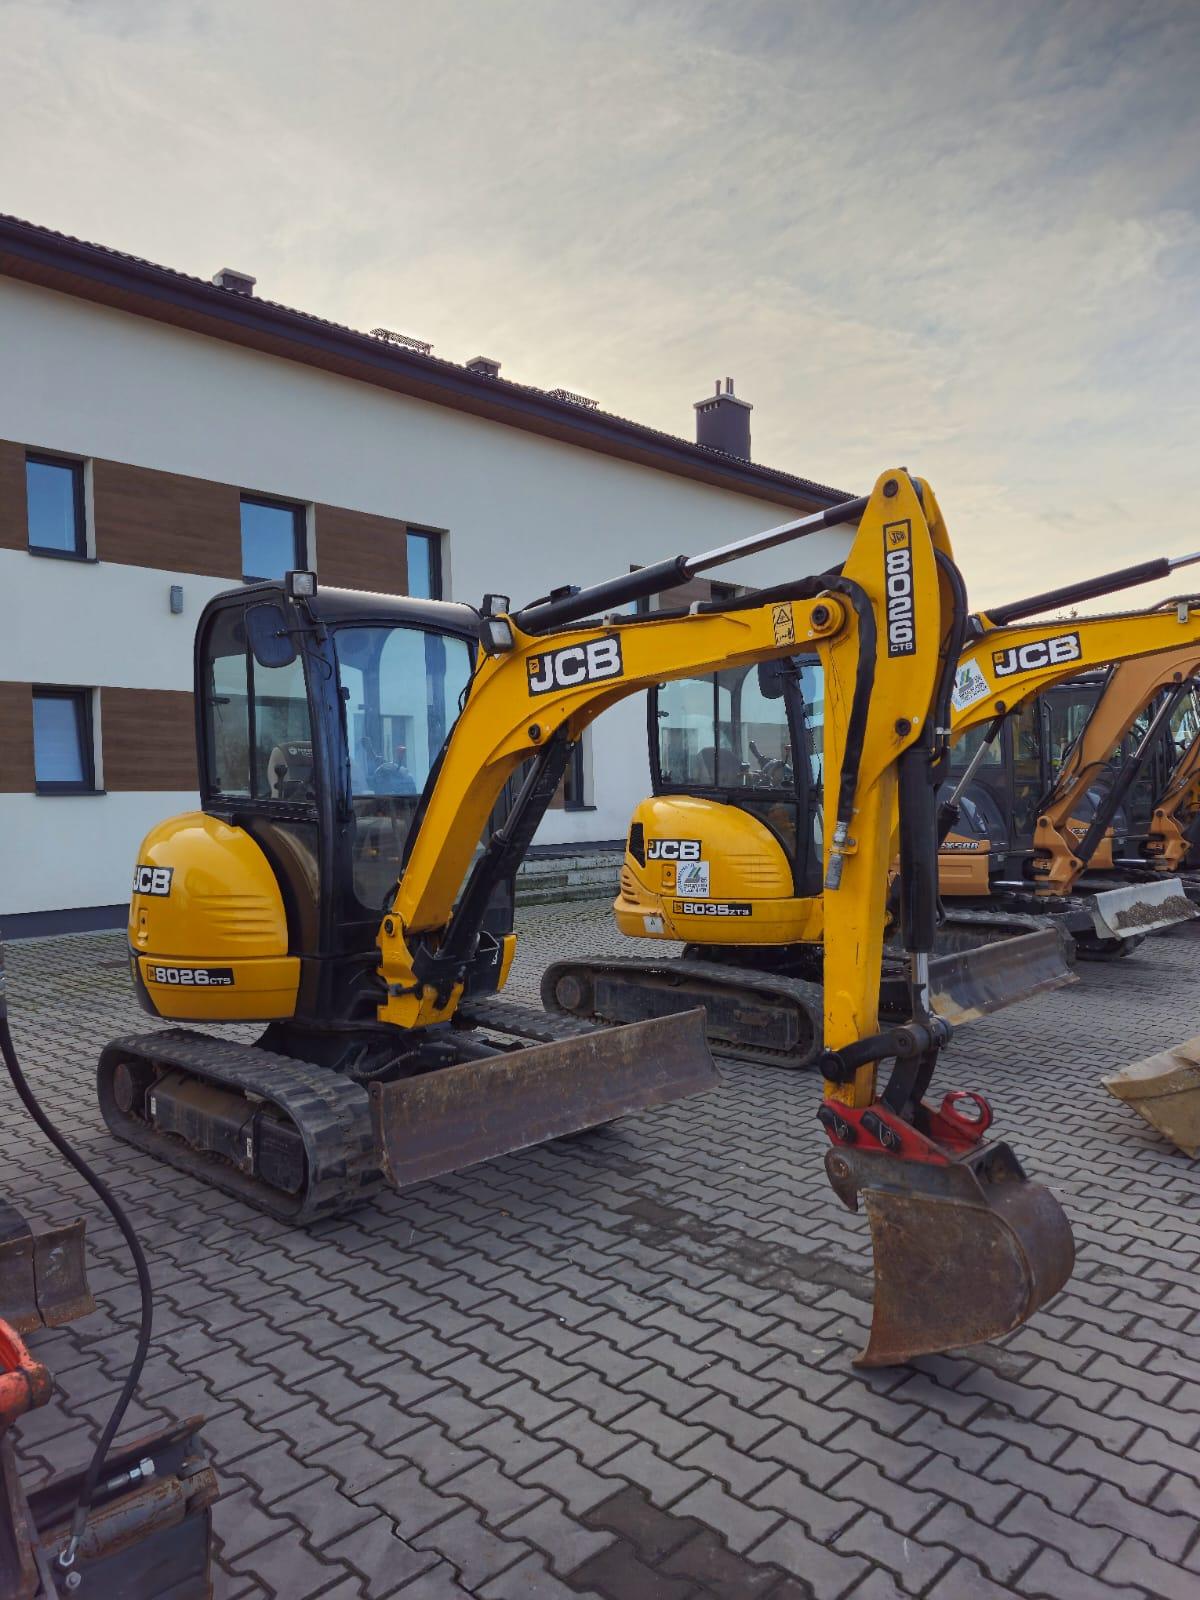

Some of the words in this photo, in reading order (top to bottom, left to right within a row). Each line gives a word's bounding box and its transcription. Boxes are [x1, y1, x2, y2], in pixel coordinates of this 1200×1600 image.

[886, 549, 913, 644] 8026
[890, 642, 913, 651] CTS
[995, 634, 1079, 676] JCB
[530, 638, 621, 692] JCB
[648, 841, 700, 860] JCB
[133, 867, 171, 894] JCB
[683, 903, 729, 916] 8035
[155, 967, 210, 985] 8026
[209, 977, 231, 985] CTS
